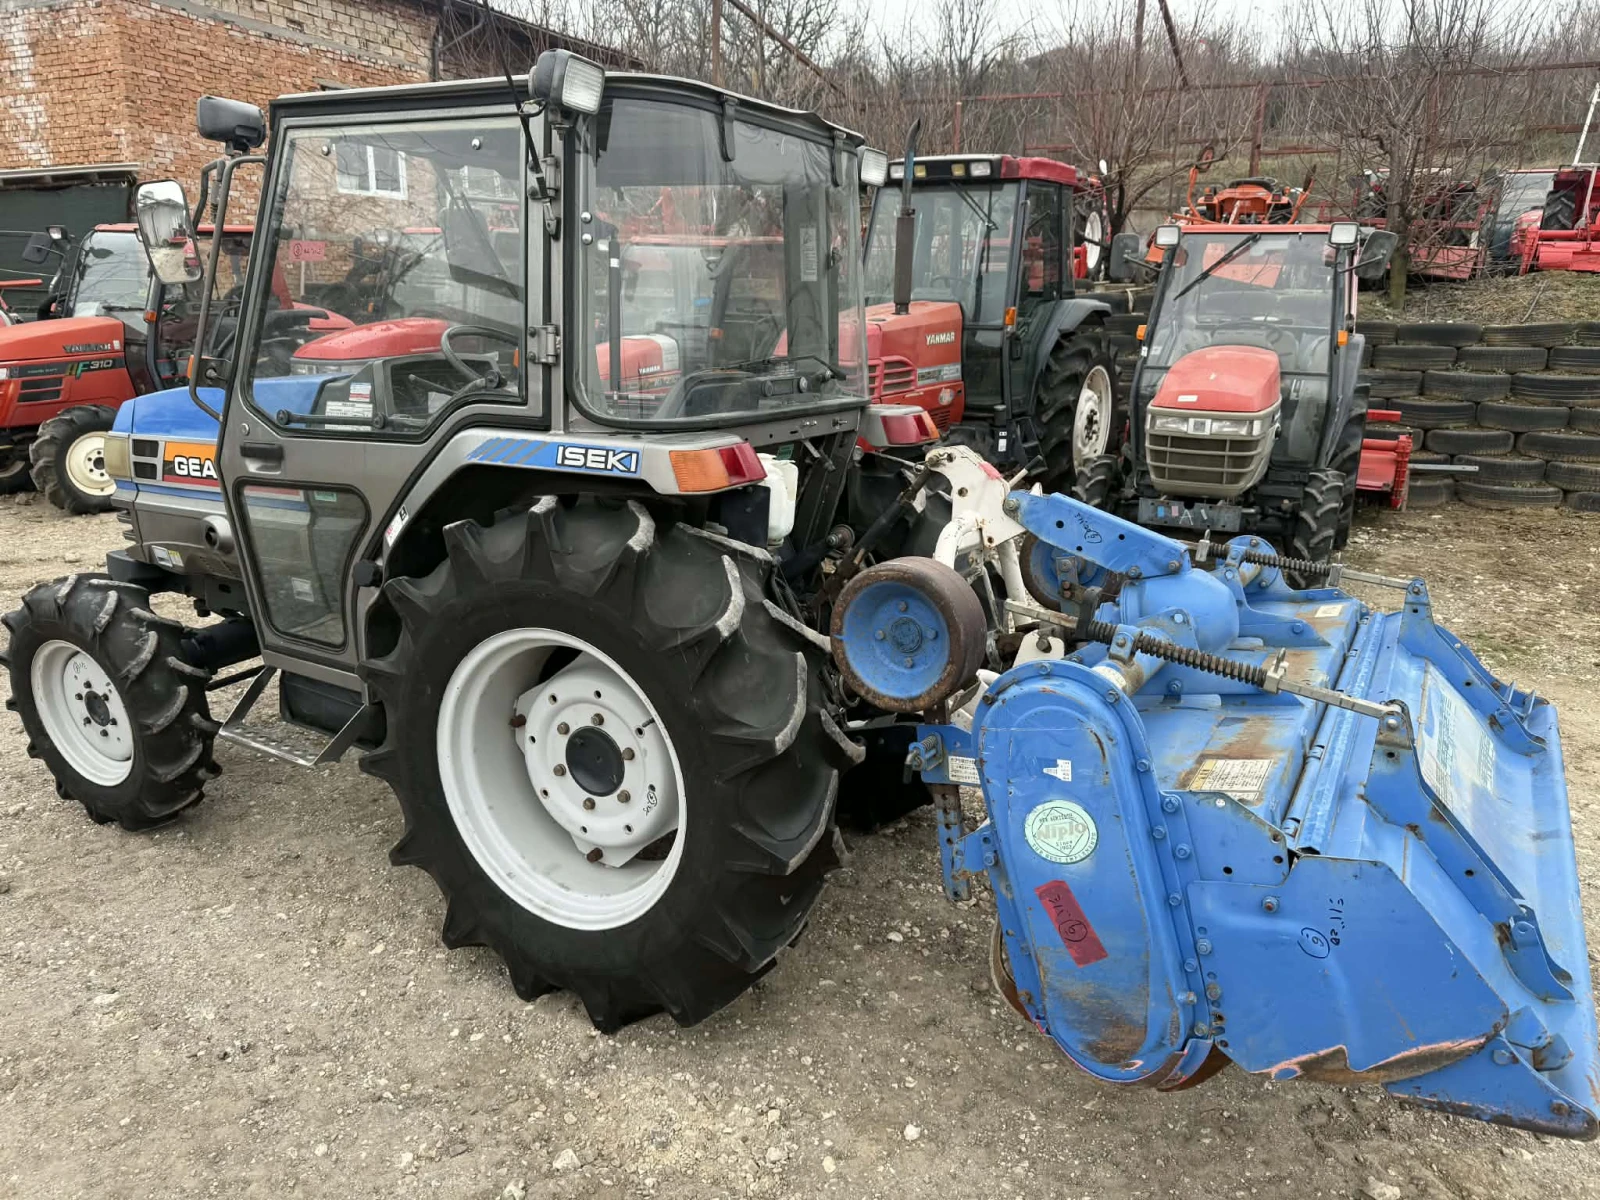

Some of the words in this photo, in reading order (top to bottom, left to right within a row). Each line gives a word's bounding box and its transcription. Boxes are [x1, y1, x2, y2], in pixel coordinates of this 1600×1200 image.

[926, 331, 955, 346] YANMAR
[174, 456, 218, 479] GEA
[556, 445, 638, 473] ISEKI
[1036, 821, 1087, 841] Niplo
